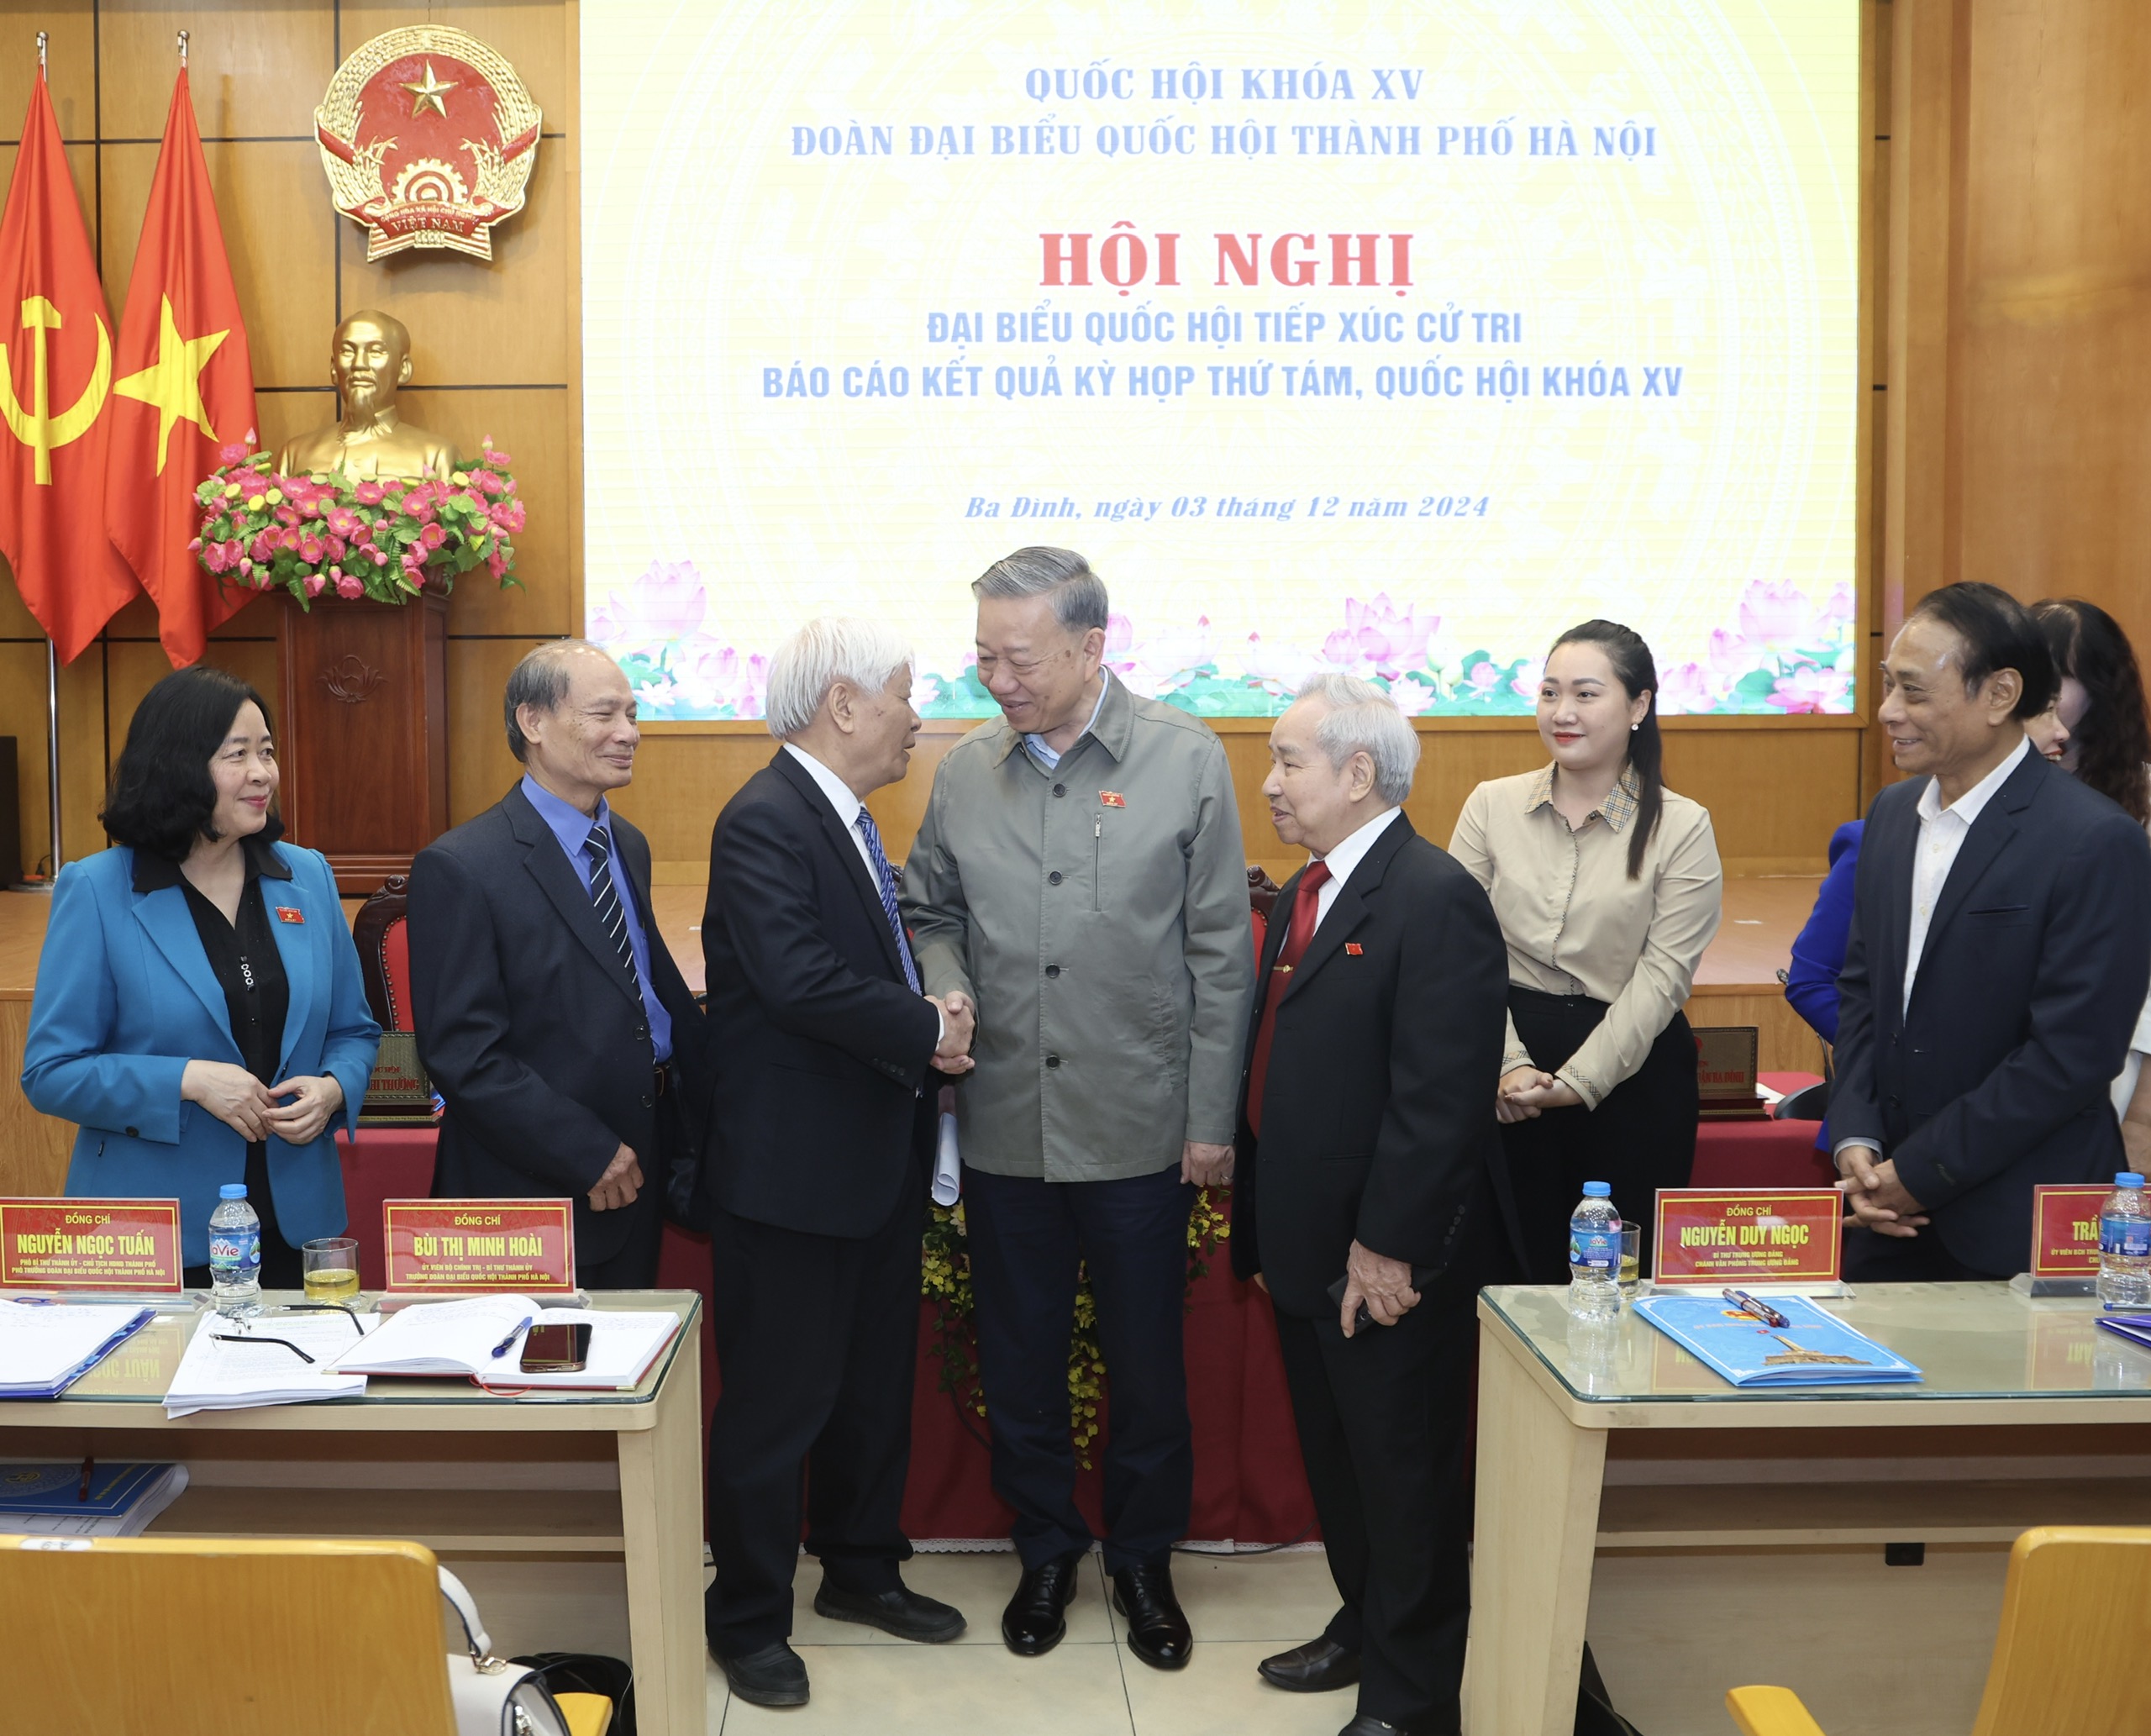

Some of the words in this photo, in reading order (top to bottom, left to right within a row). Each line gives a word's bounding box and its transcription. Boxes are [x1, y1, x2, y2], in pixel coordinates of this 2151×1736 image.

[1025, 57, 1133, 102] QUỐC
[1151, 61, 1223, 105] HỘI
[1241, 61, 1354, 100] KHÓA
[1371, 70, 1423, 100] XV
[792, 119, 893, 155] ĐOÀN
[910, 126, 975, 160] ĐẠI
[991, 113, 1081, 155] BIỂU
[1097, 114, 1195, 157] QUỐC
[1211, 119, 1276, 161] HỘI
[1291, 119, 1420, 155] THÀNH
[1438, 115, 1514, 155] PHỐ
[1528, 120, 1578, 156] HÀ
[1594, 120, 1656, 161] NỘI
[391, 215, 427, 232] VIỆT
[431, 217, 465, 233] NAM
[1039, 220, 1181, 297] HỘI
[1214, 232, 1413, 297] NGHỊ
[927, 312, 983, 348] ĐẠI
[997, 298, 1073, 343] BIỂU
[1085, 302, 1175, 346] QUỐC
[1187, 305, 1242, 349] HỘI
[1254, 302, 1326, 343] TIẾP
[1338, 305, 1404, 343] XÚC
[1417, 302, 1464, 343] CỬ
[1471, 313, 1522, 343] TRI
[763, 360, 829, 397] BÁO
[843, 360, 909, 397] CÁO
[922, 355, 982, 397] KẾT
[995, 355, 1063, 401] QUẢ
[1075, 359, 1116, 397] KỲ
[1128, 365, 1195, 403] HỌP
[1207, 359, 1274, 397] THỨ
[1282, 359, 1364, 400] TÁM,
[1375, 354, 1464, 401] QUỐC
[1476, 359, 1530, 403] HỘI
[1543, 360, 1630, 397] KHÓA
[1642, 366, 1683, 397] XV
[965, 497, 1001, 518] Ba
[1011, 496, 1081, 521] Đình,
[1094, 499, 1162, 522] ngày
[1171, 496, 1207, 517] 03
[1216, 496, 1296, 521] tháng
[1307, 497, 1340, 517] 12
[1348, 498, 1408, 517] năm
[1417, 496, 1489, 517] 2024
[65, 1212, 92, 1224] ĐỒNG
[94, 1213, 111, 1224] CHÍ
[455, 1213, 482, 1226] ĐỒNG
[484, 1214, 501, 1225] CHÍ
[1726, 1204, 1754, 1217] ĐỒNG
[1755, 1205, 1772, 1216] CHÍ
[1680, 1219, 1737, 1247] NGUYỄN
[1740, 1225, 1767, 1246] DUY
[1770, 1224, 1809, 1249] NGỌC
[2072, 1214, 2099, 1241] TRẦ
[17, 1228, 72, 1255] NGUYỄN
[76, 1234, 114, 1259] NGỌC
[118, 1229, 155, 1255] TUẤN
[212, 1244, 239, 1256] aVie
[413, 1233, 438, 1256] BÙI
[441, 1236, 464, 1261] THỊ
[467, 1236, 505, 1256] MINH
[509, 1233, 542, 1257] HOÀI
